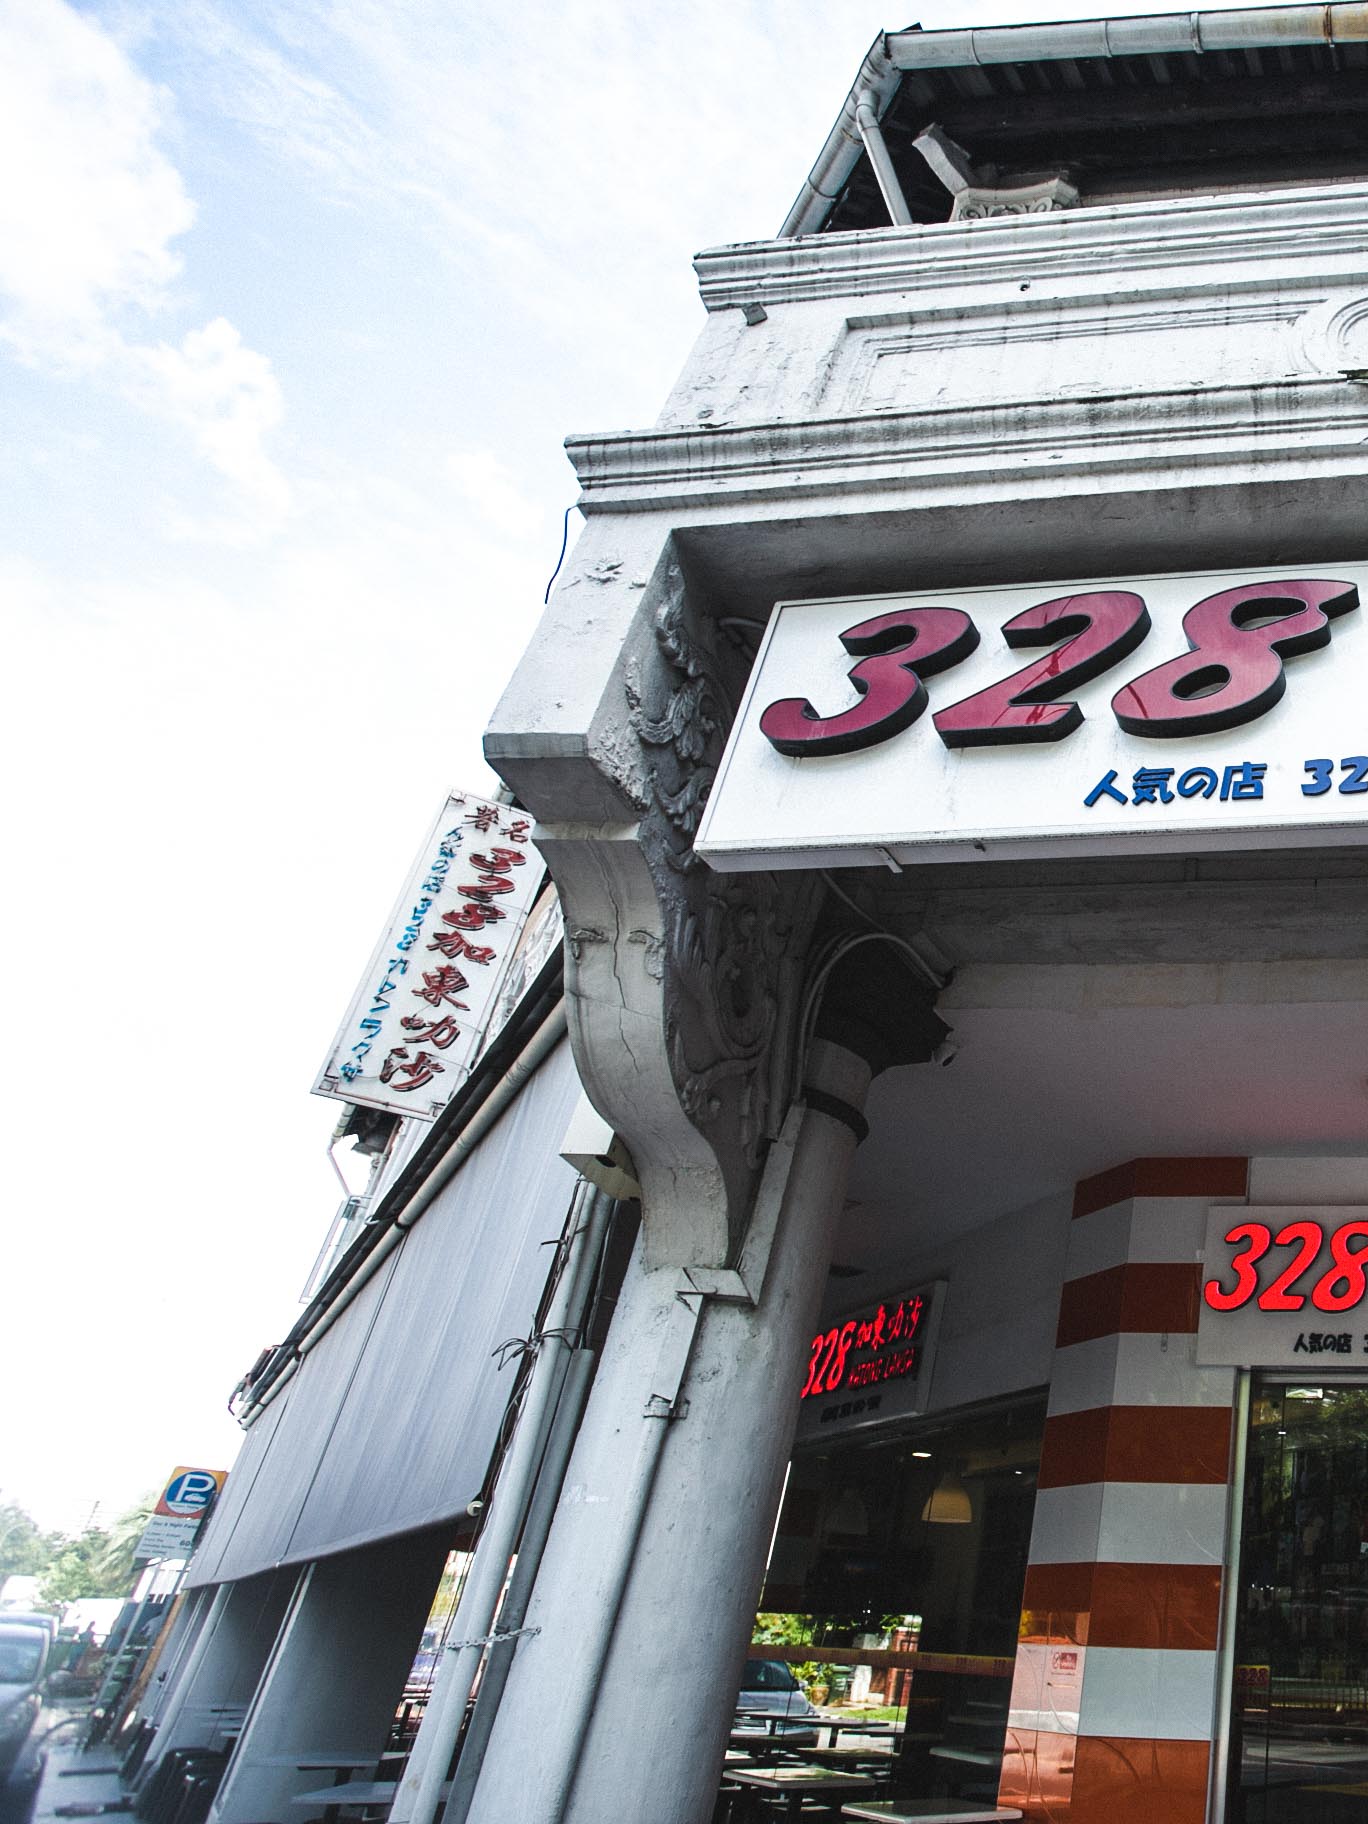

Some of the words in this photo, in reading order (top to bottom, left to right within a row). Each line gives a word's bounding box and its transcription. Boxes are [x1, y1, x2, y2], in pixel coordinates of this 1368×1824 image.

[760, 579, 1360, 757] 328
[1083, 761, 1268, 807] 人気の店
[1293, 1333, 1352, 1354] 人気の店
[175, 1474, 215, 1502] P
